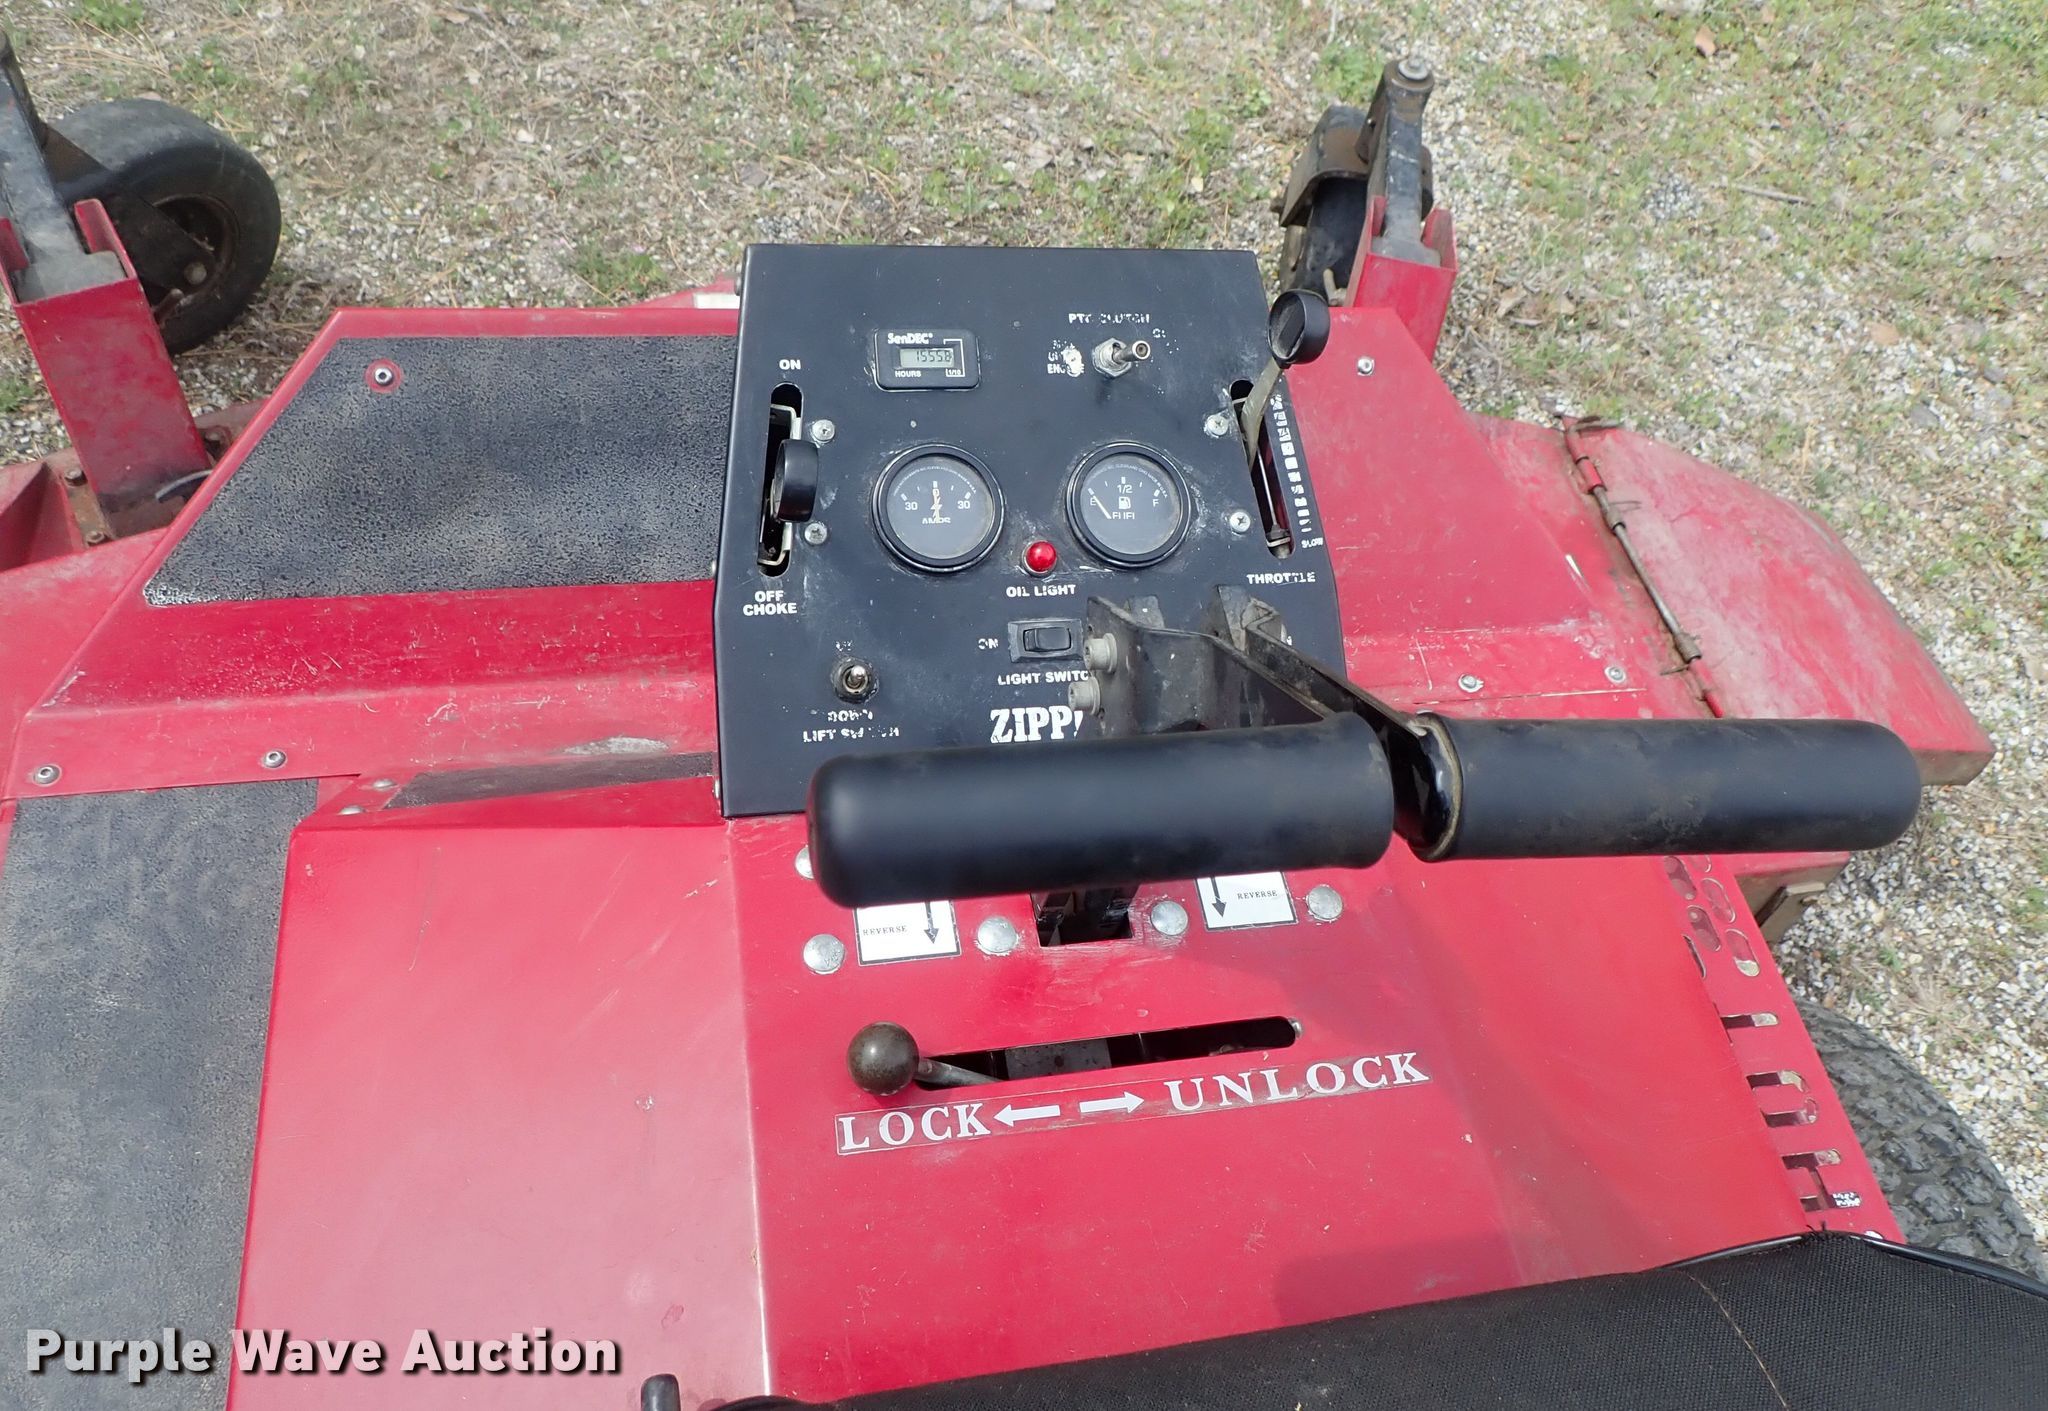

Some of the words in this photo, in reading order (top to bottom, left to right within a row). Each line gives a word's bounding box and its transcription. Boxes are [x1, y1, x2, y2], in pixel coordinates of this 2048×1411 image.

[779, 359, 801, 370] ON
[895, 370, 922, 378] HOURS
[1117, 484, 1133, 494] 1/2
[904, 501, 918, 511] 30
[957, 500, 971, 510] 30
[1153, 499, 1160, 507] F
[1246, 571, 1316, 585] THROTTLE
[754, 590, 784, 602] OFF
[1006, 586, 1030, 598] OIL
[1034, 584, 1076, 597] LIGHT
[743, 602, 798, 617] CHOKE
[978, 638, 999, 650] ON
[998, 673, 1041, 686] LIGHT
[1045, 670, 1089, 684] SWITC
[803, 729, 837, 743] LIFT
[1237, 889, 1278, 900] REVERSE
[862, 925, 908, 936] REVERSE
[838, 1101, 992, 1151] LOCK
[1164, 1051, 1430, 1112] UNLOCK
